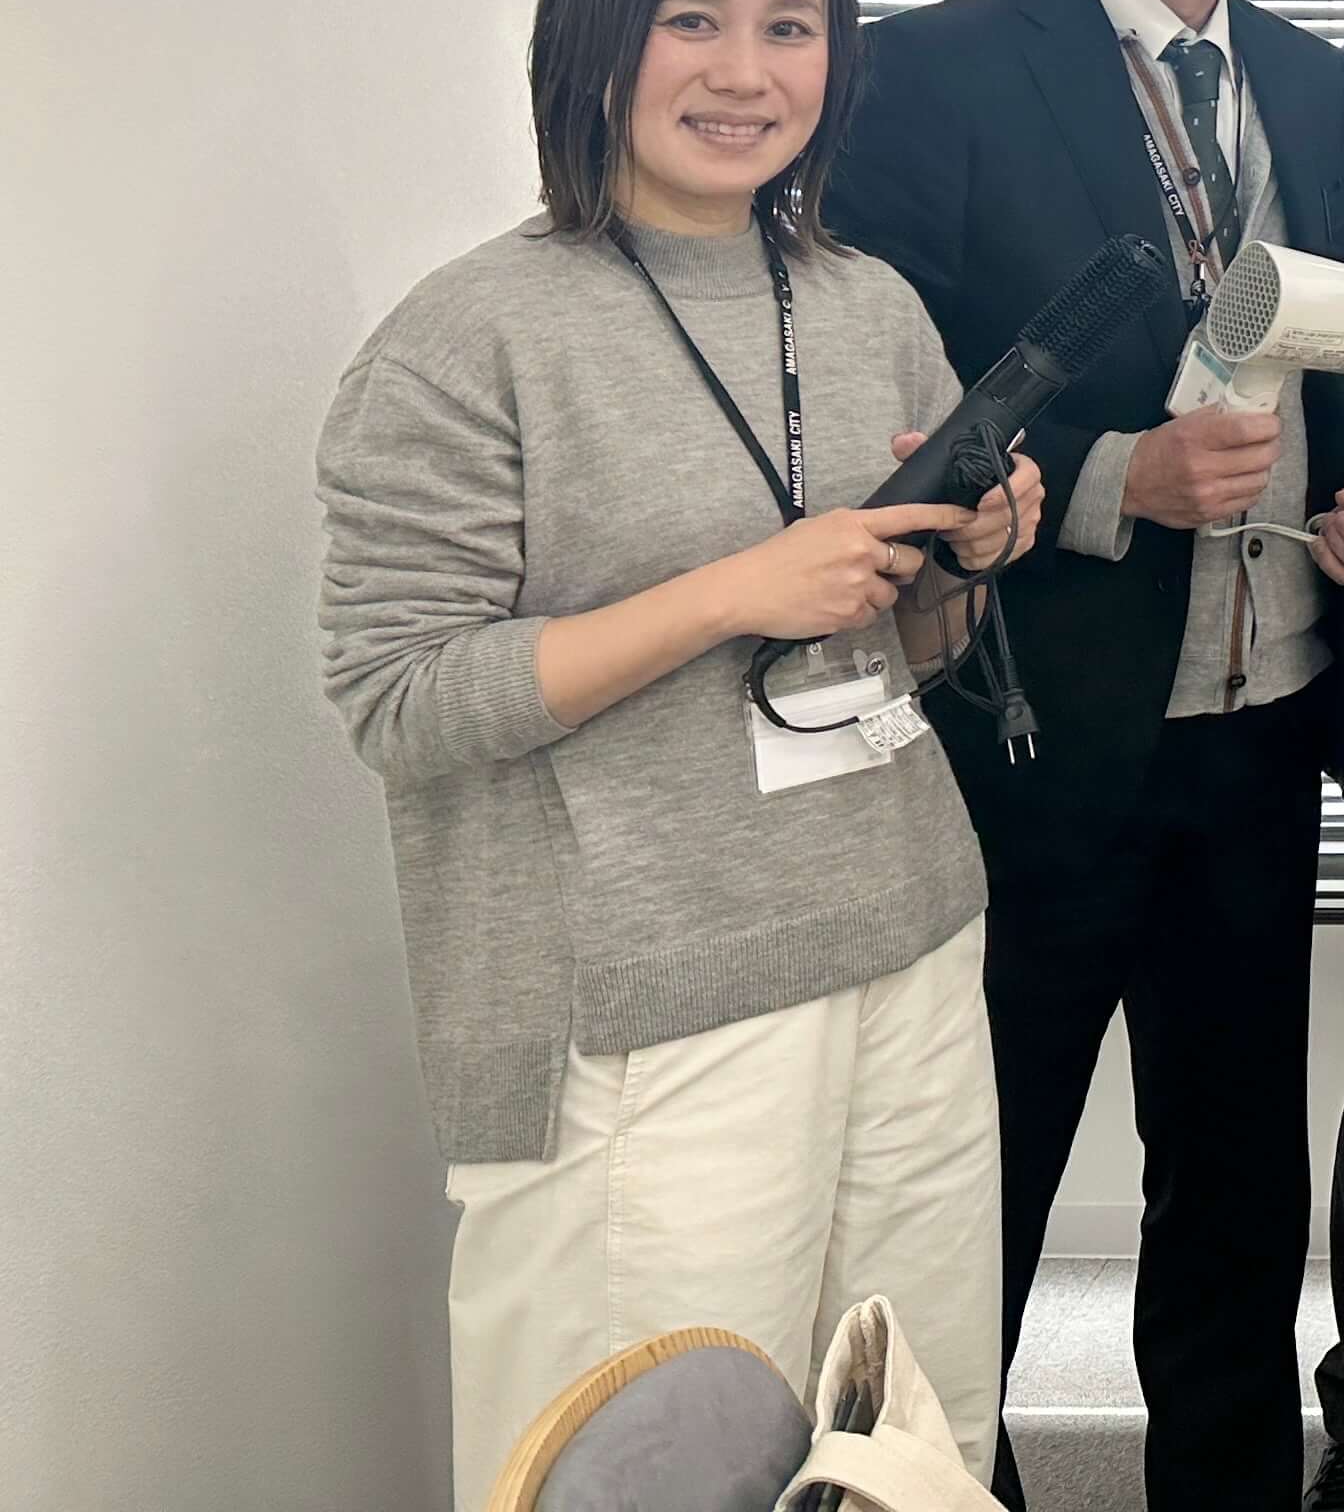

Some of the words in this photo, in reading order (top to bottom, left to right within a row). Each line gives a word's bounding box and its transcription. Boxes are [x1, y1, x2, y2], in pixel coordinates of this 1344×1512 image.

[1143, 134, 1174, 193] AMAGASAKI
[1167, 193, 1185, 216] CITY
[783, 312, 798, 376] AMAGASAKI
[788, 410, 801, 435] CITY
[790, 439, 804, 508] AMAGASAKI
